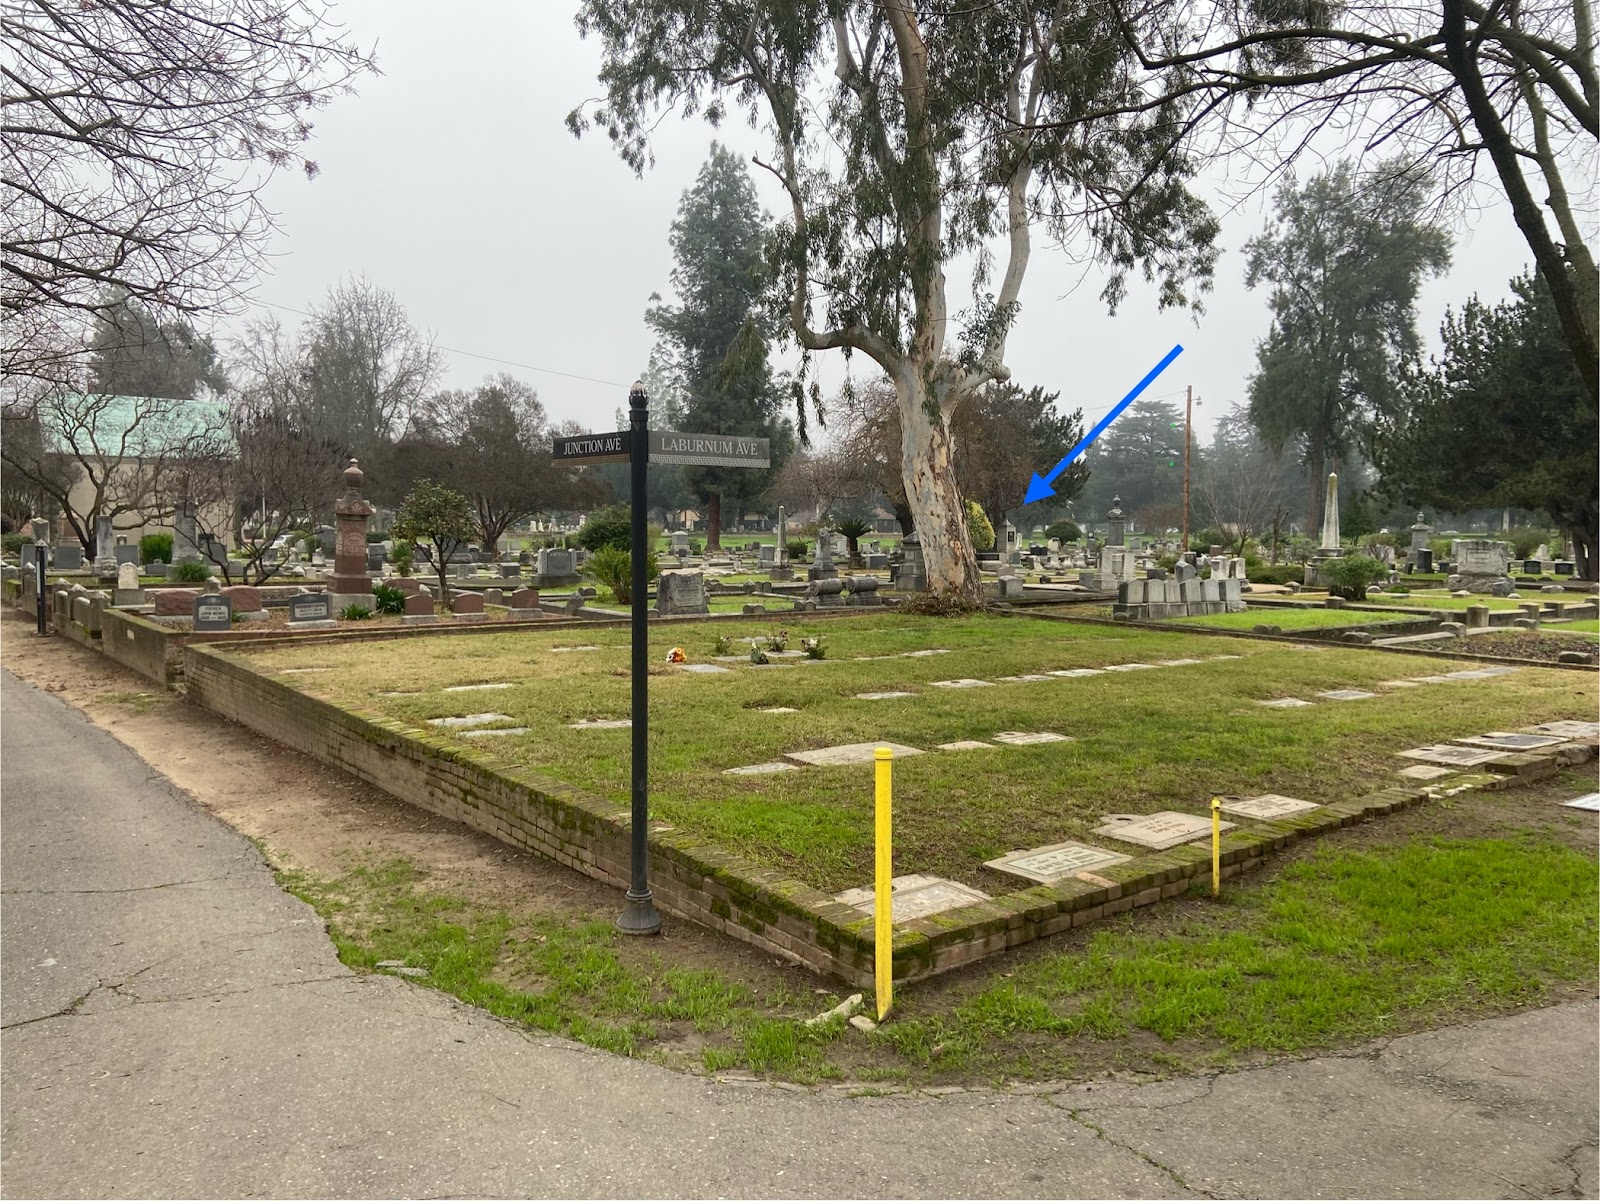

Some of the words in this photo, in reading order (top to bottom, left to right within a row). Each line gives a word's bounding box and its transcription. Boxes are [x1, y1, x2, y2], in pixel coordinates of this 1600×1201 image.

[563, 439, 604, 455] JUNCTION
[604, 437, 622, 452] AVE
[661, 437, 733, 454] LABURNUM
[735, 442, 758, 456] AVE
